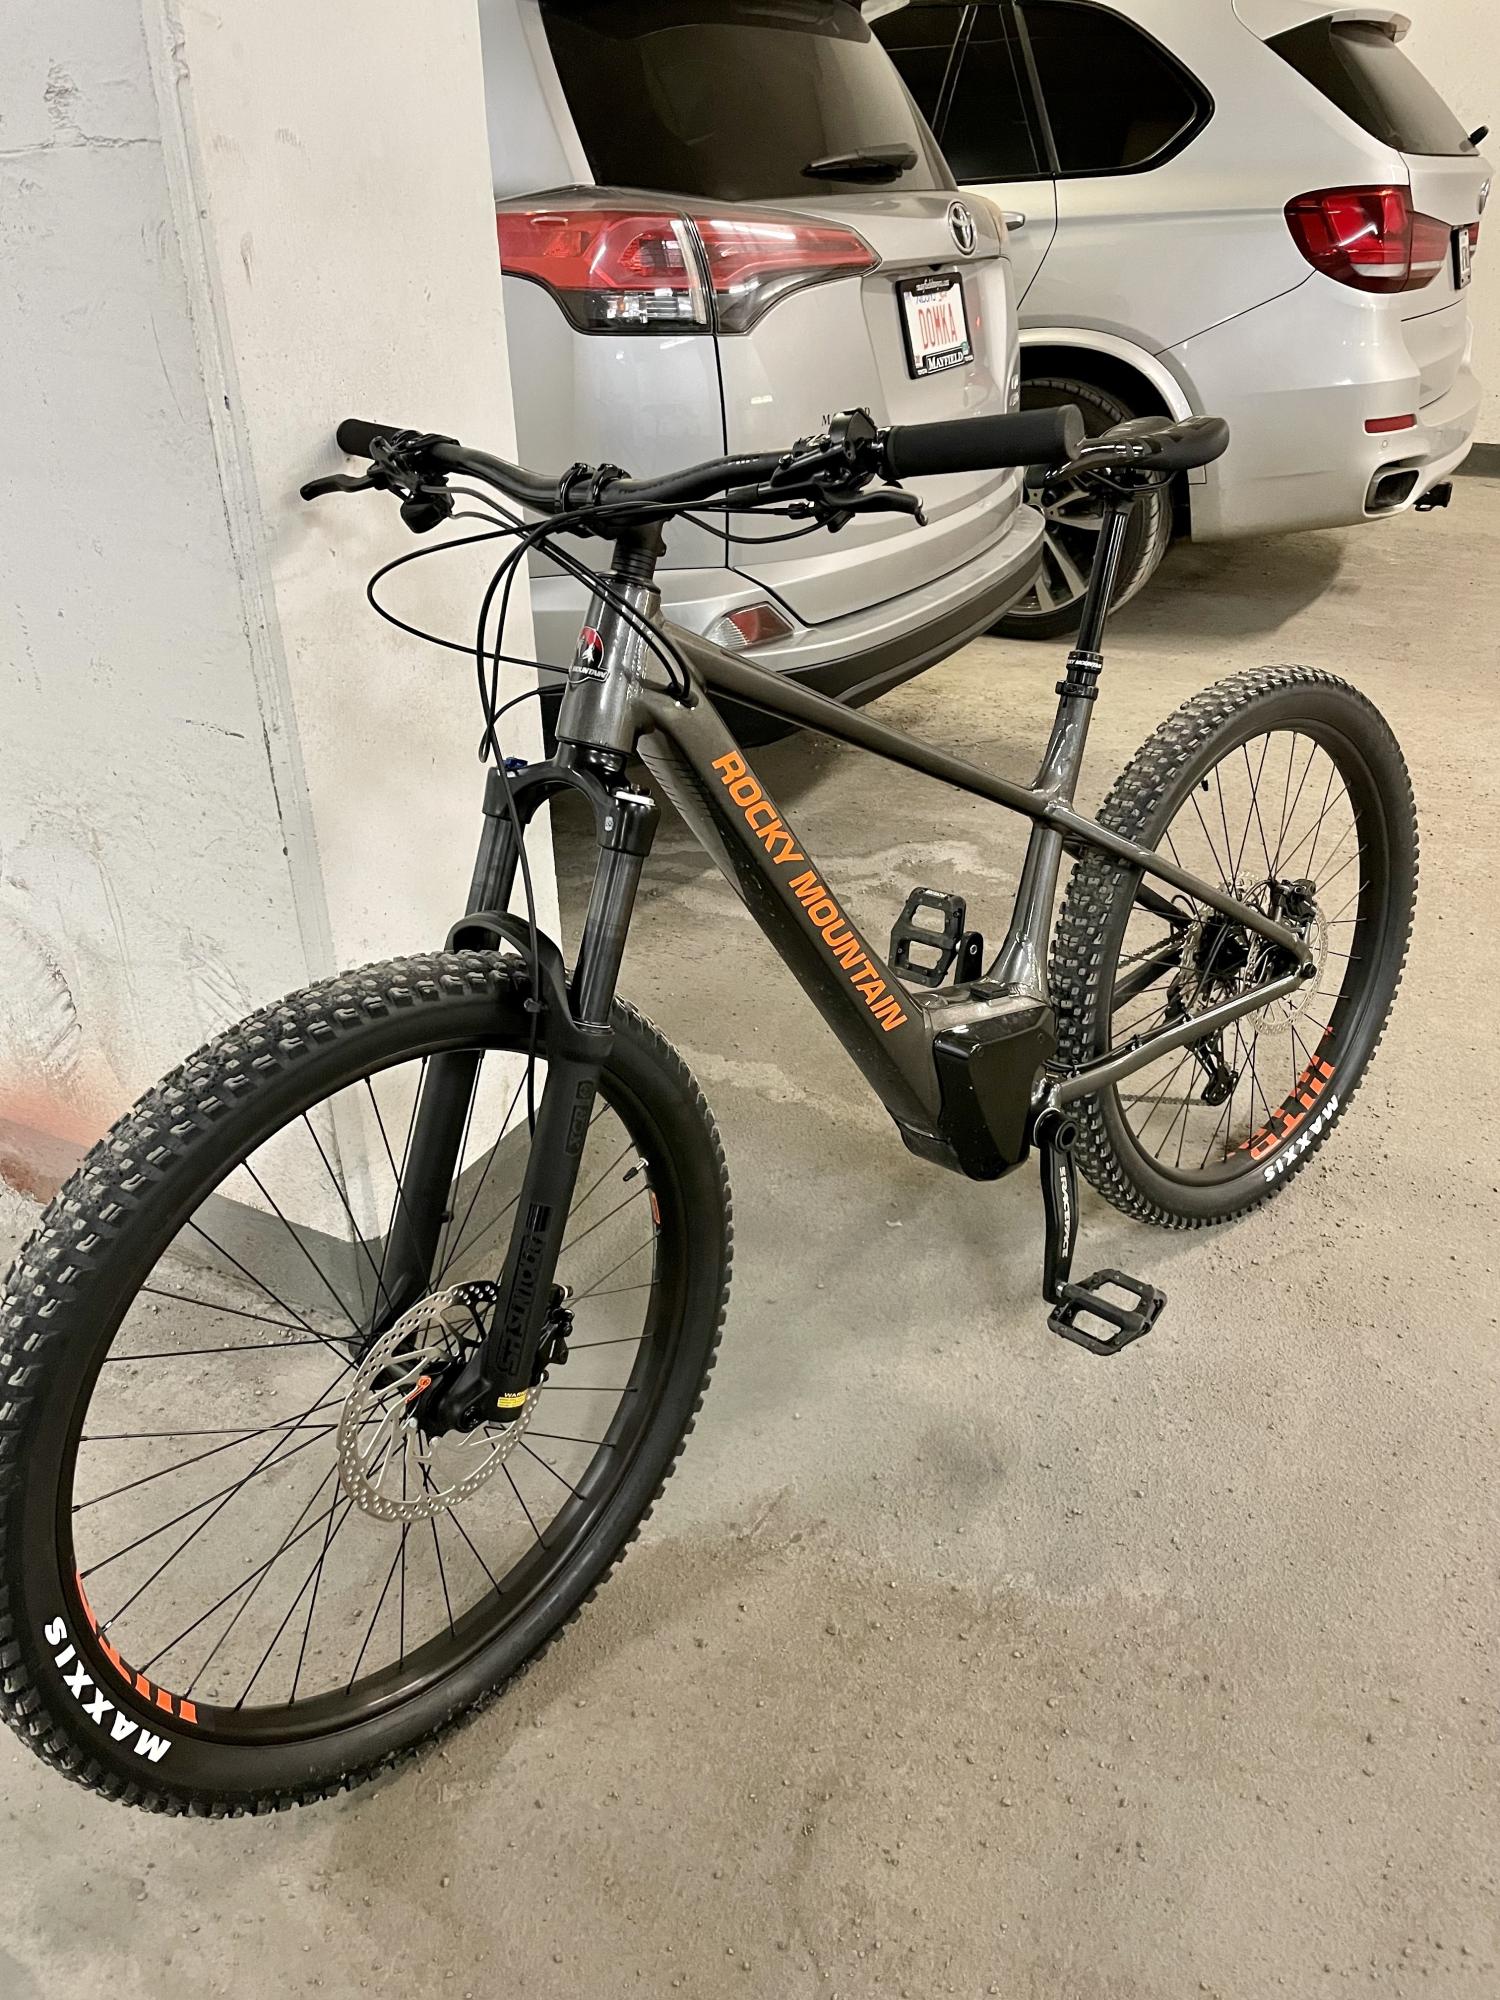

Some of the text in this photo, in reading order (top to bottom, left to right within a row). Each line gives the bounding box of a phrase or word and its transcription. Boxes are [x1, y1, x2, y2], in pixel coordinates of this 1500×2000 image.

[927, 351, 964, 370] MAYFIELD
[711, 750, 908, 1032] ROCKY MOUNTAIN
[1263, 1094, 1339, 1182] MAXXIS
[44, 1616, 172, 1763] MAXXIS
